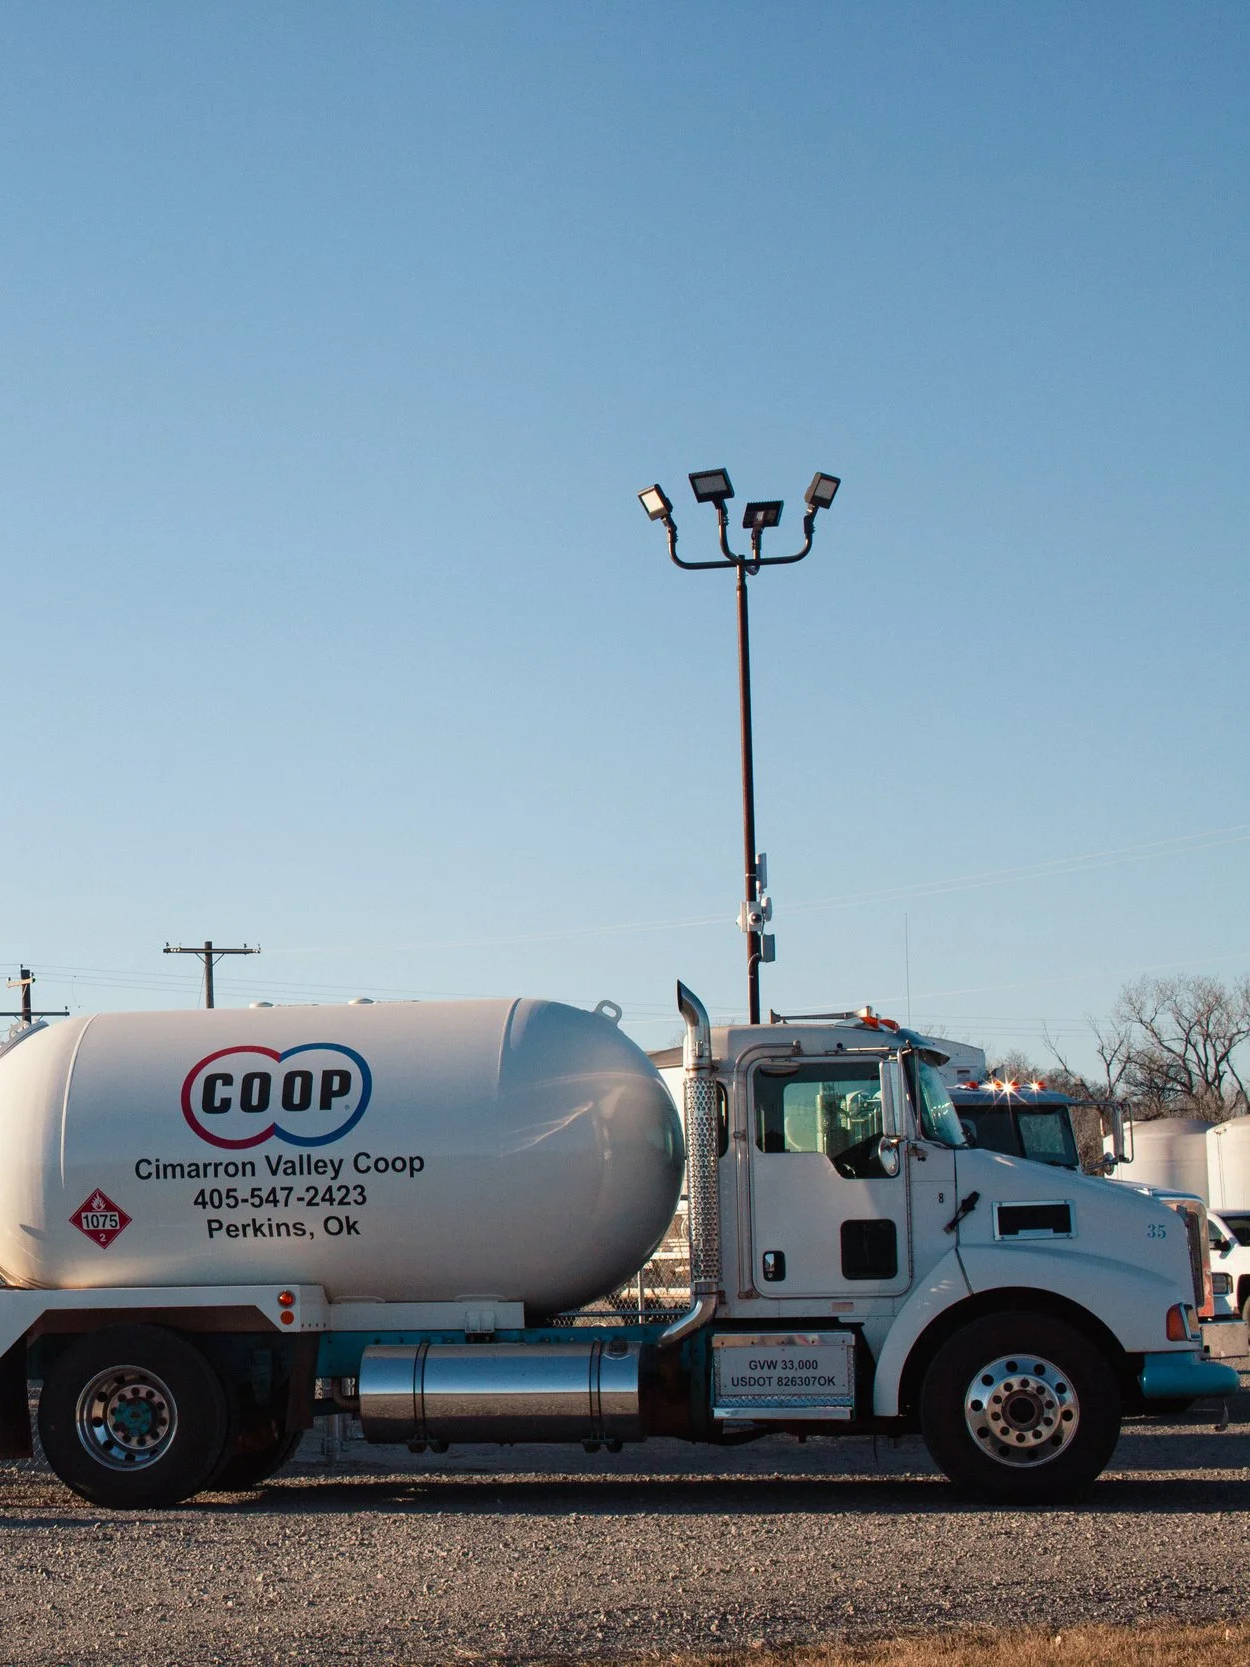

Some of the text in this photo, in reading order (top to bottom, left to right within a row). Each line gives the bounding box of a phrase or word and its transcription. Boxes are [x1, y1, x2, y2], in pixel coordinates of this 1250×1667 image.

[201, 1070, 352, 1114] COOP
[134, 1151, 425, 1181] Cimarron Valley Coop
[193, 1185, 367, 1210] 405-547-2423
[938, 1192, 944, 1203] 8
[83, 1213, 119, 1230] 1075
[207, 1215, 361, 1239] Perkins, Ok
[100, 1233, 107, 1243] 2
[1147, 1223, 1167, 1239] 35
[749, 1360, 818, 1370] GVW 33,000
[731, 1376, 836, 1387] USDOT 826307OK
